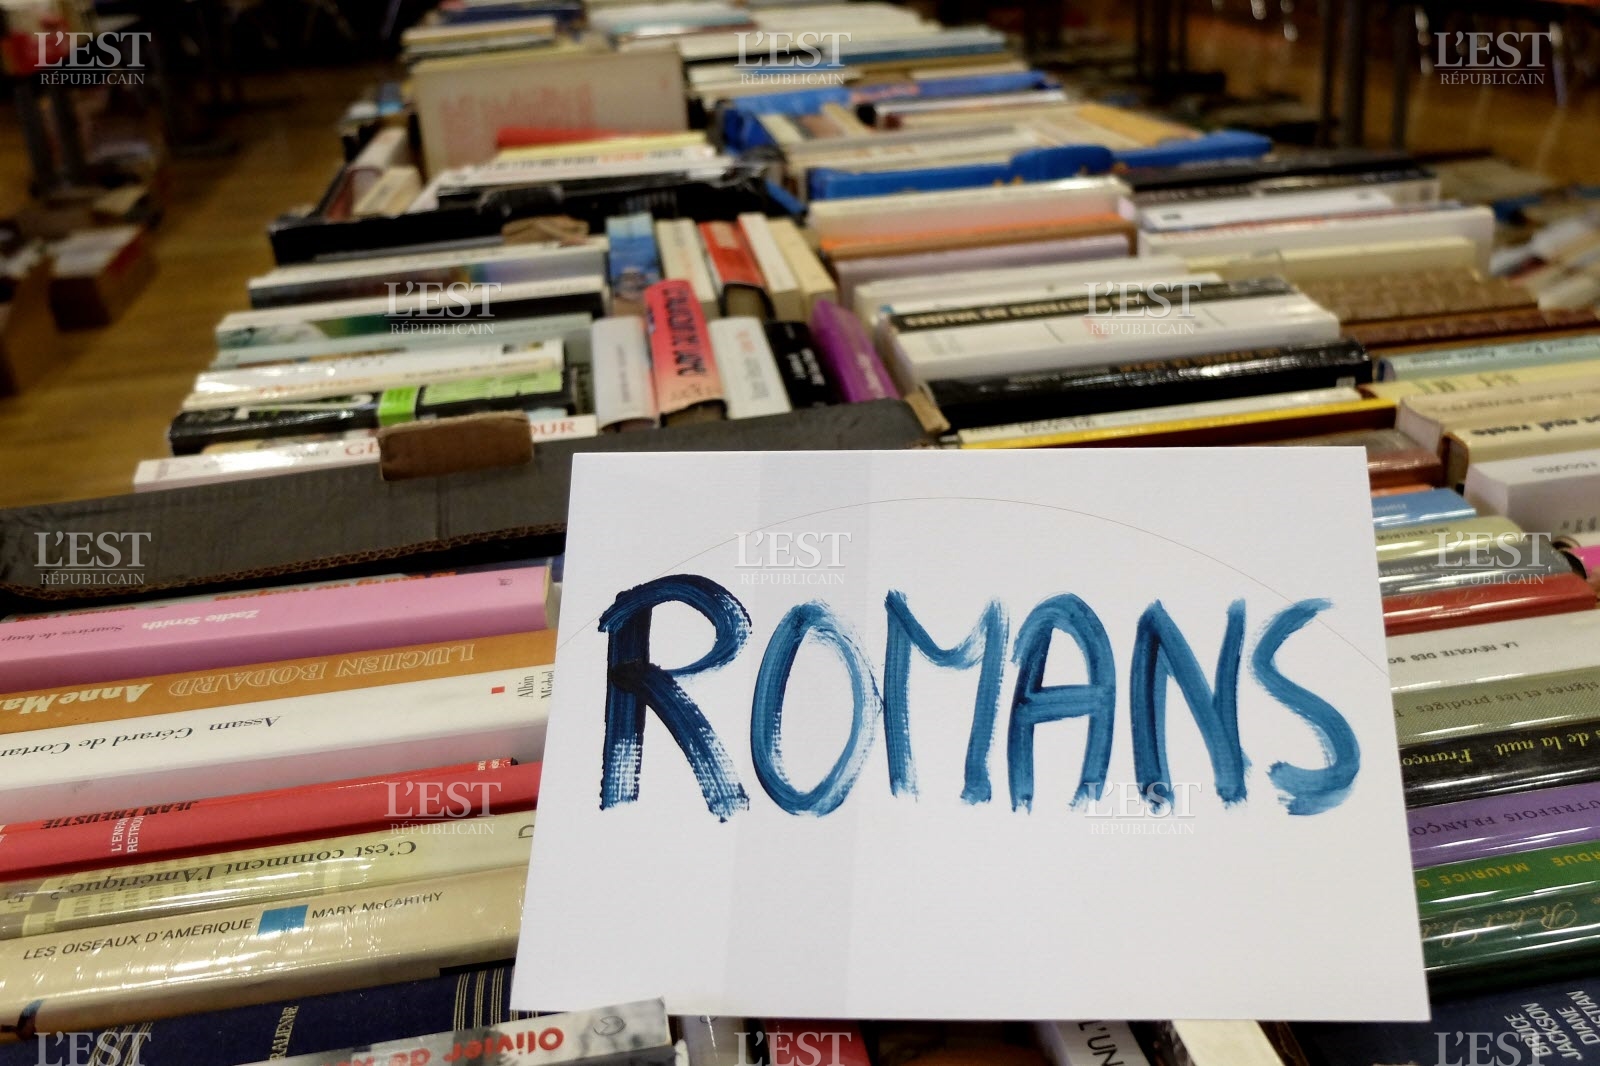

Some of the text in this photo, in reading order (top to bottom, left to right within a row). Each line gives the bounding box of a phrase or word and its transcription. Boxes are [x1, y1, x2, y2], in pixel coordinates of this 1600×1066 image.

[141, 609, 260, 631] Zadie Smith
[39, 630, 57, 640] de
[1501, 640, 1518, 650] LA
[1410, 651, 1436, 662] DES
[1440, 644, 1497, 658] RÉVOLTE
[168, 643, 474, 698] LUCIEN BODARD
[517, 675, 534, 698] Albin
[598, 573, 1362, 822] ROMANS
[0, 682, 153, 716] Anne Ma
[1416, 695, 1491, 714] prodiges
[1496, 692, 1518, 705] les
[208, 714, 281, 734] Assam
[78, 737, 106, 751] de
[112, 726, 194, 748] Gérard
[1540, 736, 1561, 751] la
[1566, 731, 1589, 747] de
[1401, 747, 1473, 766] Franço
[1494, 740, 1534, 757] nuit
[142, 800, 199, 816] JEAN
[1410, 815, 1495, 837] FRANÇO
[354, 839, 417, 861] C'est
[225, 848, 344, 876] comment
[64, 865, 218, 895] l'Amérique
[1439, 863, 1529, 885] MAURICE
[23, 944, 57, 961] LES
[61, 933, 139, 957] OISEAUX
[145, 917, 255, 943] D'AMERIQUE
[311, 904, 355, 921] MARY
[1503, 1012, 1553, 1057] BRUCE
[1521, 1001, 1583, 1061] JACKSON
[1555, 1005, 1600, 1045] DIANE
[443, 1027, 564, 1062] Olivier
